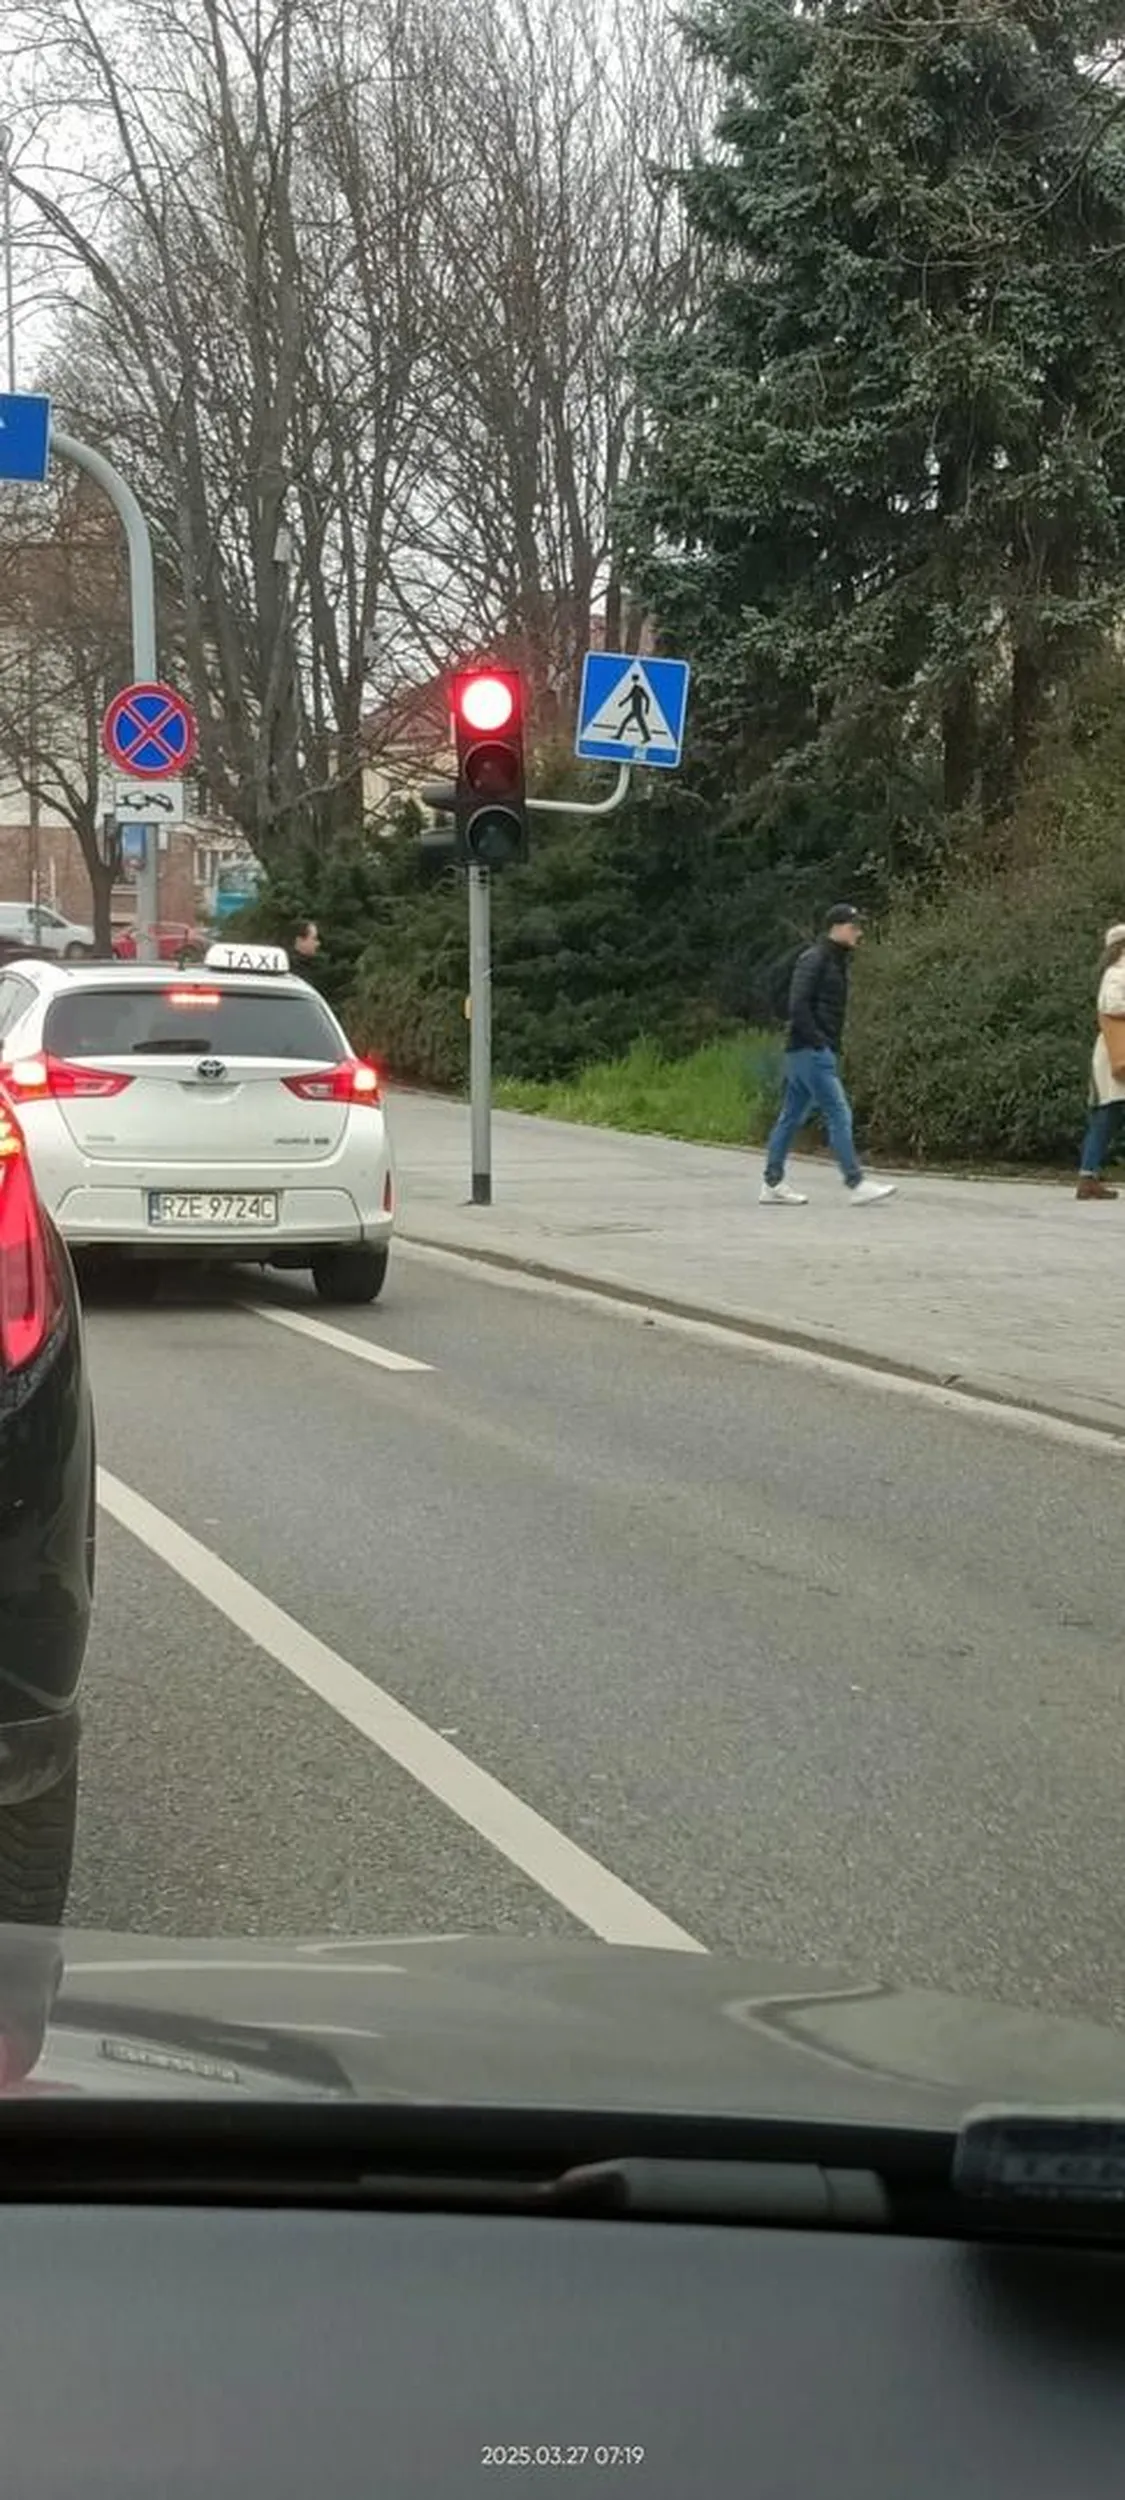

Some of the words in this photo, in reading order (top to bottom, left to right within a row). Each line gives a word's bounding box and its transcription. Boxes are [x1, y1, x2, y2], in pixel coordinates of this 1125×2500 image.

[224, 949, 279, 970] TAXI
[163, 1196, 202, 1218] RZE
[210, 1196, 273, 1219] 9724C
